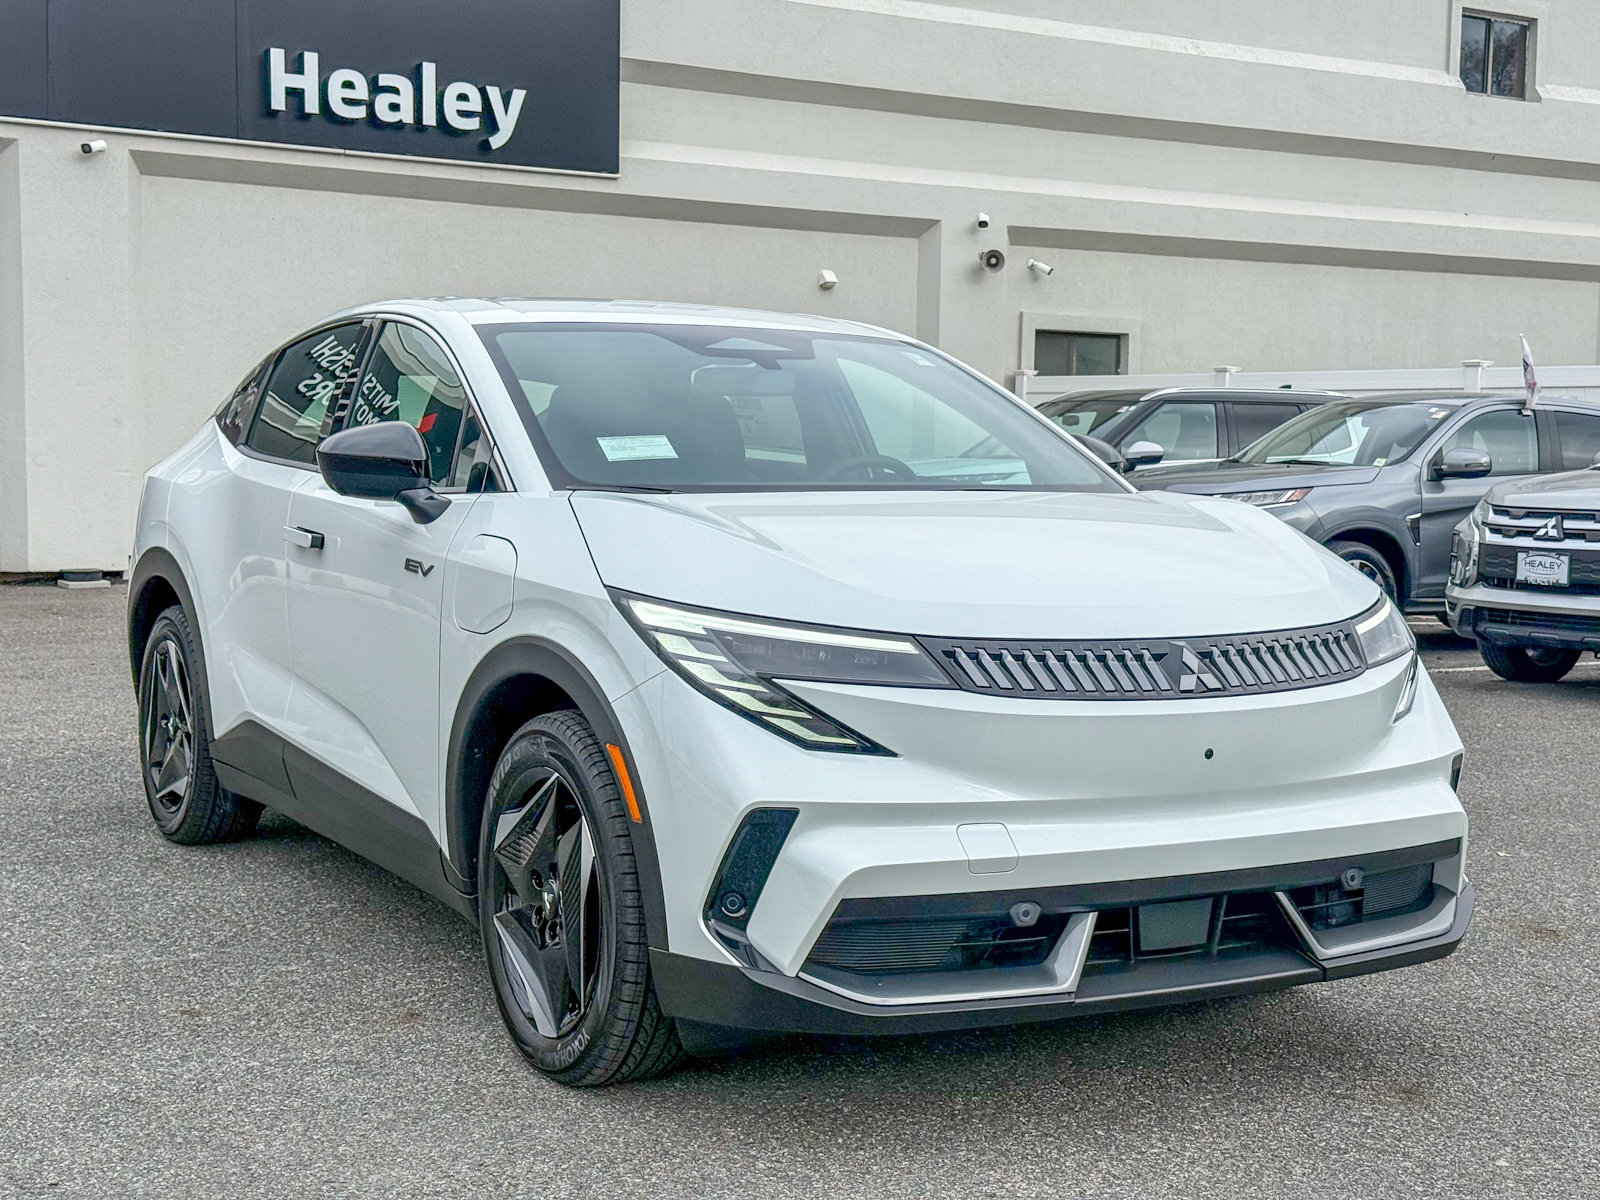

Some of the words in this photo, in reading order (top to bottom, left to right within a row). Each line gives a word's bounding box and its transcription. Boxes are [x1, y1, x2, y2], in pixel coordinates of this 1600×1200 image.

[269, 47, 527, 150] Healey
[403, 557, 435, 578] EV
[1523, 559, 1563, 570] HEALEY
